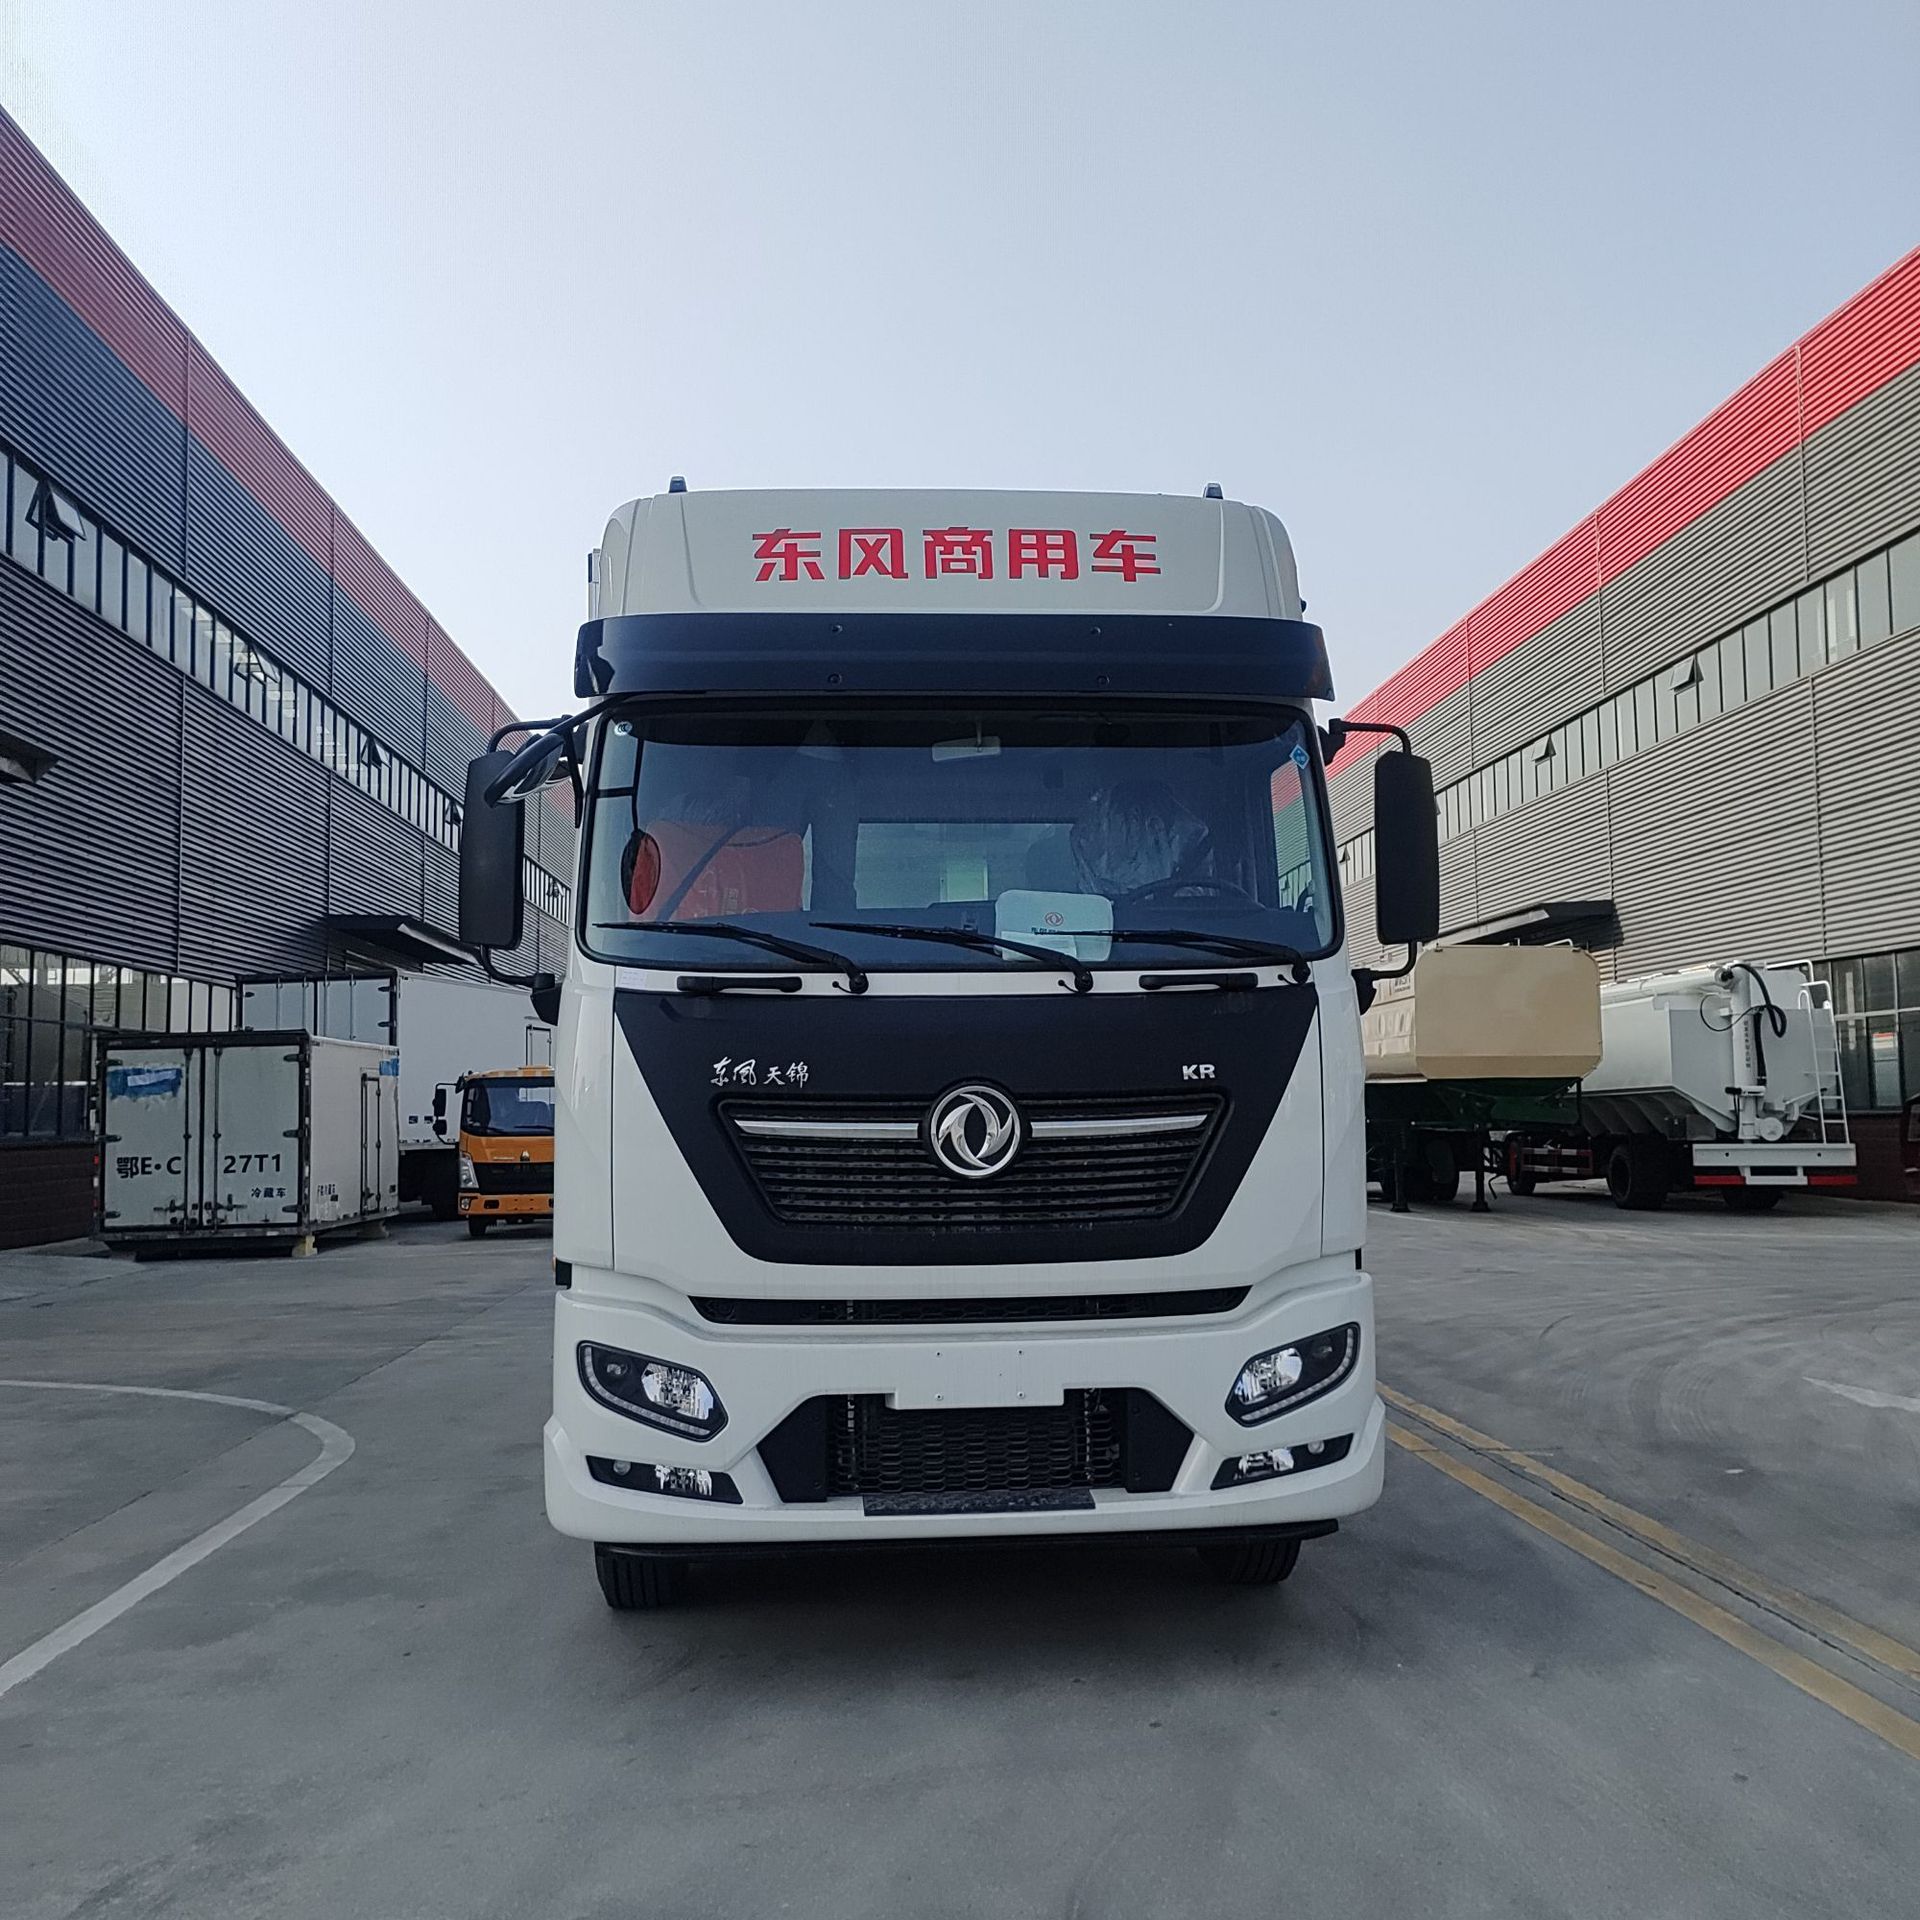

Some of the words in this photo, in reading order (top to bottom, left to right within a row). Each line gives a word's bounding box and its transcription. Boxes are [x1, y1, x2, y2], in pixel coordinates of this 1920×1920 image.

[752, 527, 1161, 582] 东风商用车
[1182, 1064, 1216, 1080] KR
[223, 1154, 281, 1174] 27T1
[251, 1187, 286, 1198] 冷藏车
